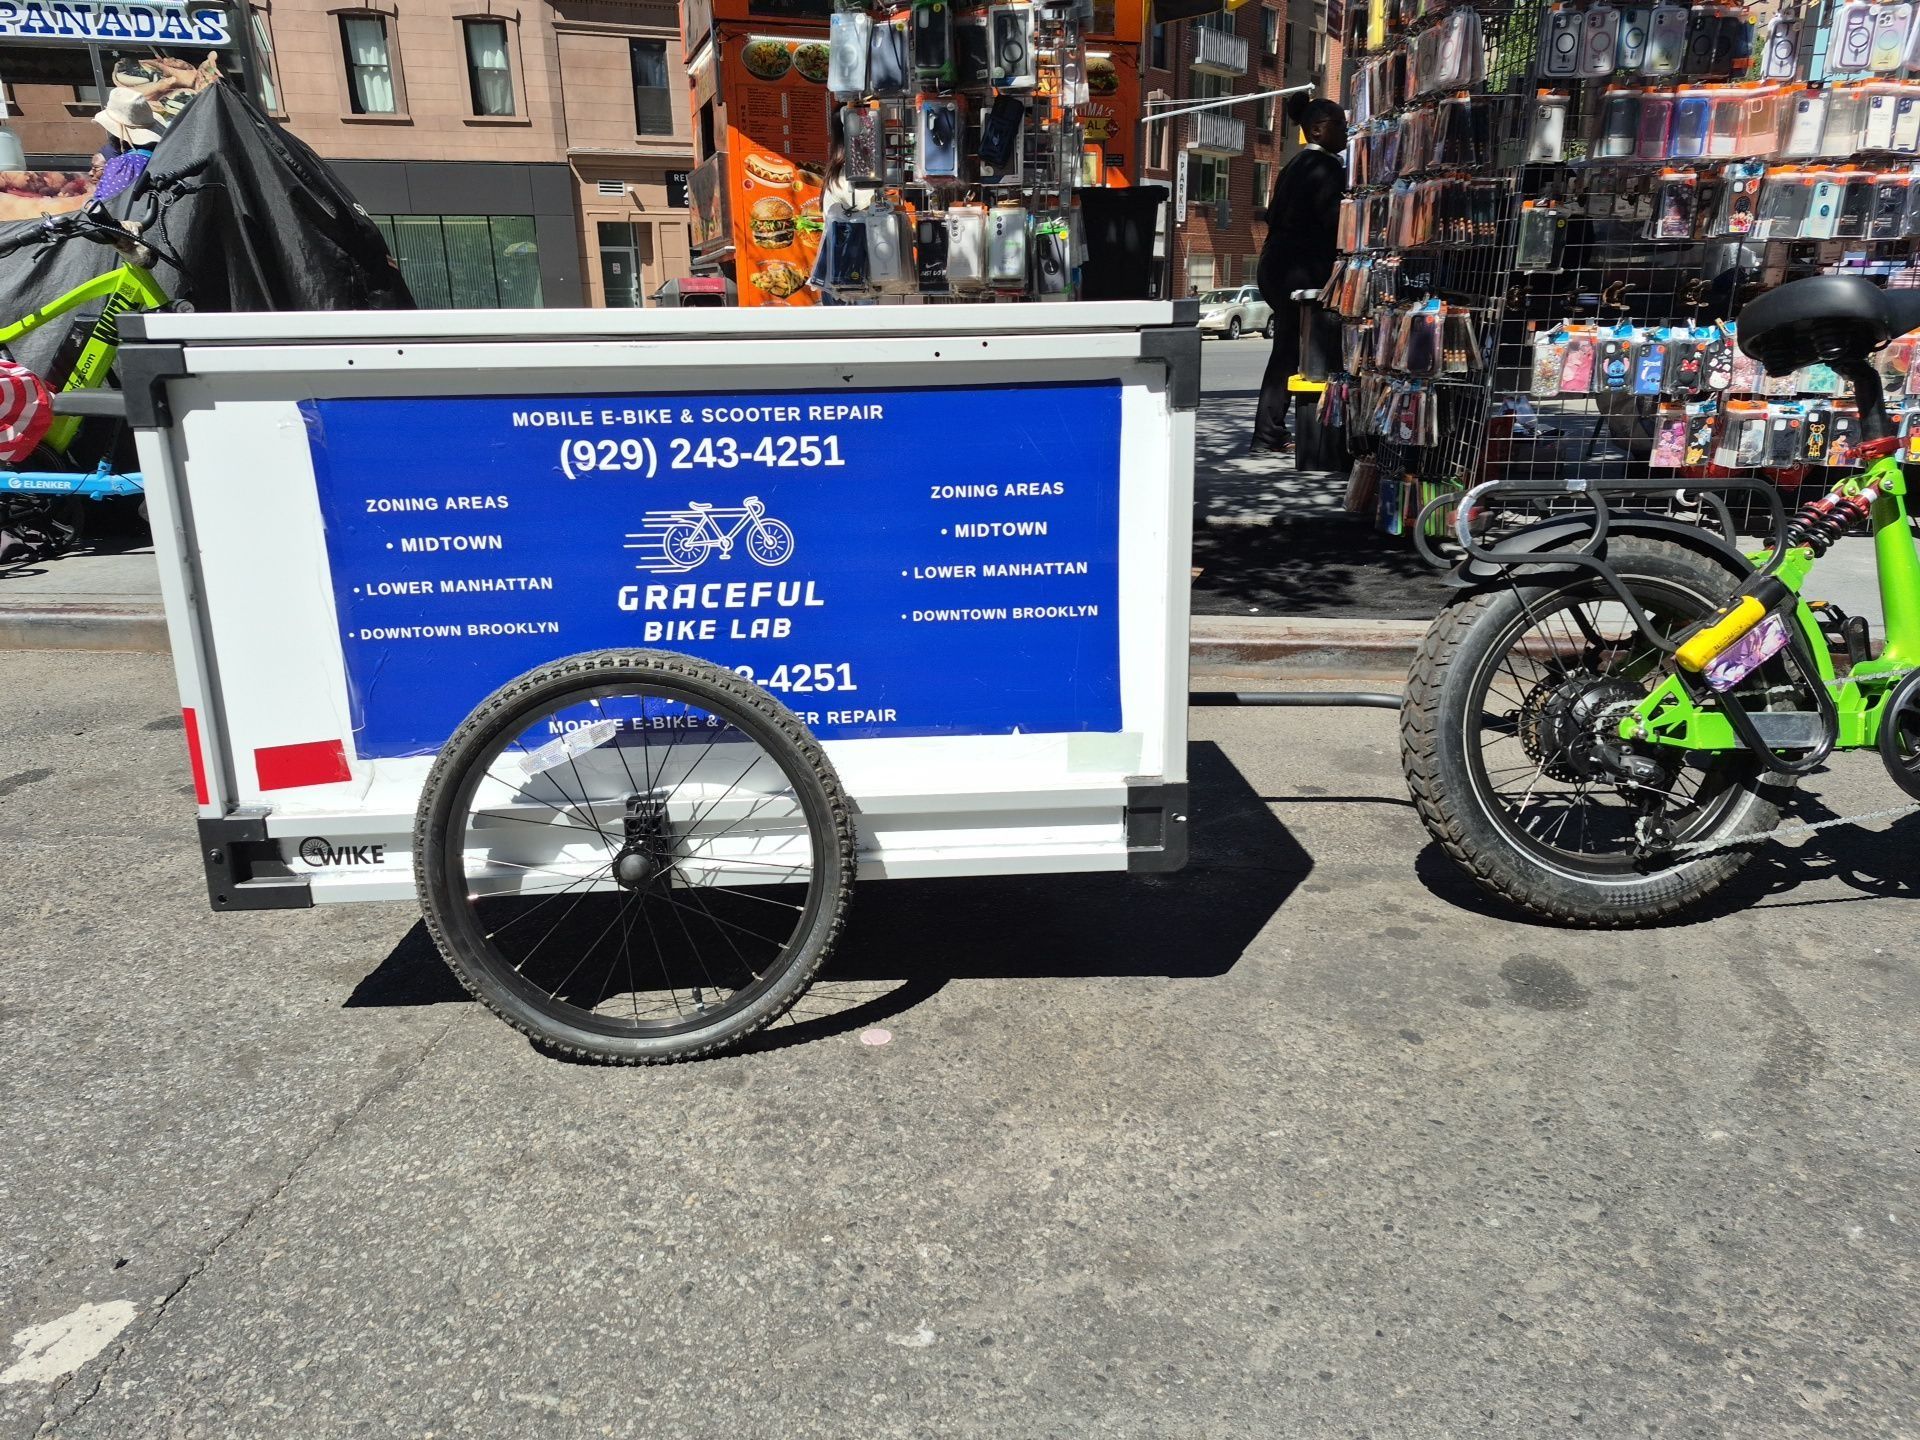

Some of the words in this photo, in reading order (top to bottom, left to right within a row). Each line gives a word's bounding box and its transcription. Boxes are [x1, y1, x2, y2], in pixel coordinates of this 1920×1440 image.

[512, 410, 594, 427] MOBILE
[601, 408, 673, 425] E-BIKE
[680, 408, 694, 424] &
[701, 406, 801, 423] SCOOTER
[808, 404, 883, 421] REPAIR
[560, 437, 658, 480] (929)
[669, 435, 846, 469] 243-4251
[23, 479, 72, 490] ELENKER
[930, 483, 998, 499] ZONING
[1004, 481, 1064, 497] AREAS
[365, 497, 439, 513] ZONING
[445, 495, 509, 510] AREAS
[955, 521, 1048, 538] MIDTOWN
[401, 534, 503, 553] MIDTOWN
[914, 565, 977, 579] LOWER
[982, 561, 1088, 577] MANHATTAN
[366, 580, 434, 596] LOWER
[440, 576, 553, 593] MANHATTAN
[617, 580, 825, 611] GRACEFUL
[912, 608, 1007, 622] DOWNTOWN
[1012, 605, 1098, 619] BROOKLYN
[360, 624, 462, 640] DOWNTOWN
[467, 621, 559, 636] BROOKLYN
[643, 619, 717, 642] BIKE
[730, 617, 792, 639] LAB
[549, 718, 624, 734] MOE
[633, 715, 698, 730] E-BIKE
[706, 714, 719, 728] &
[827, 708, 897, 725] REPAIR
